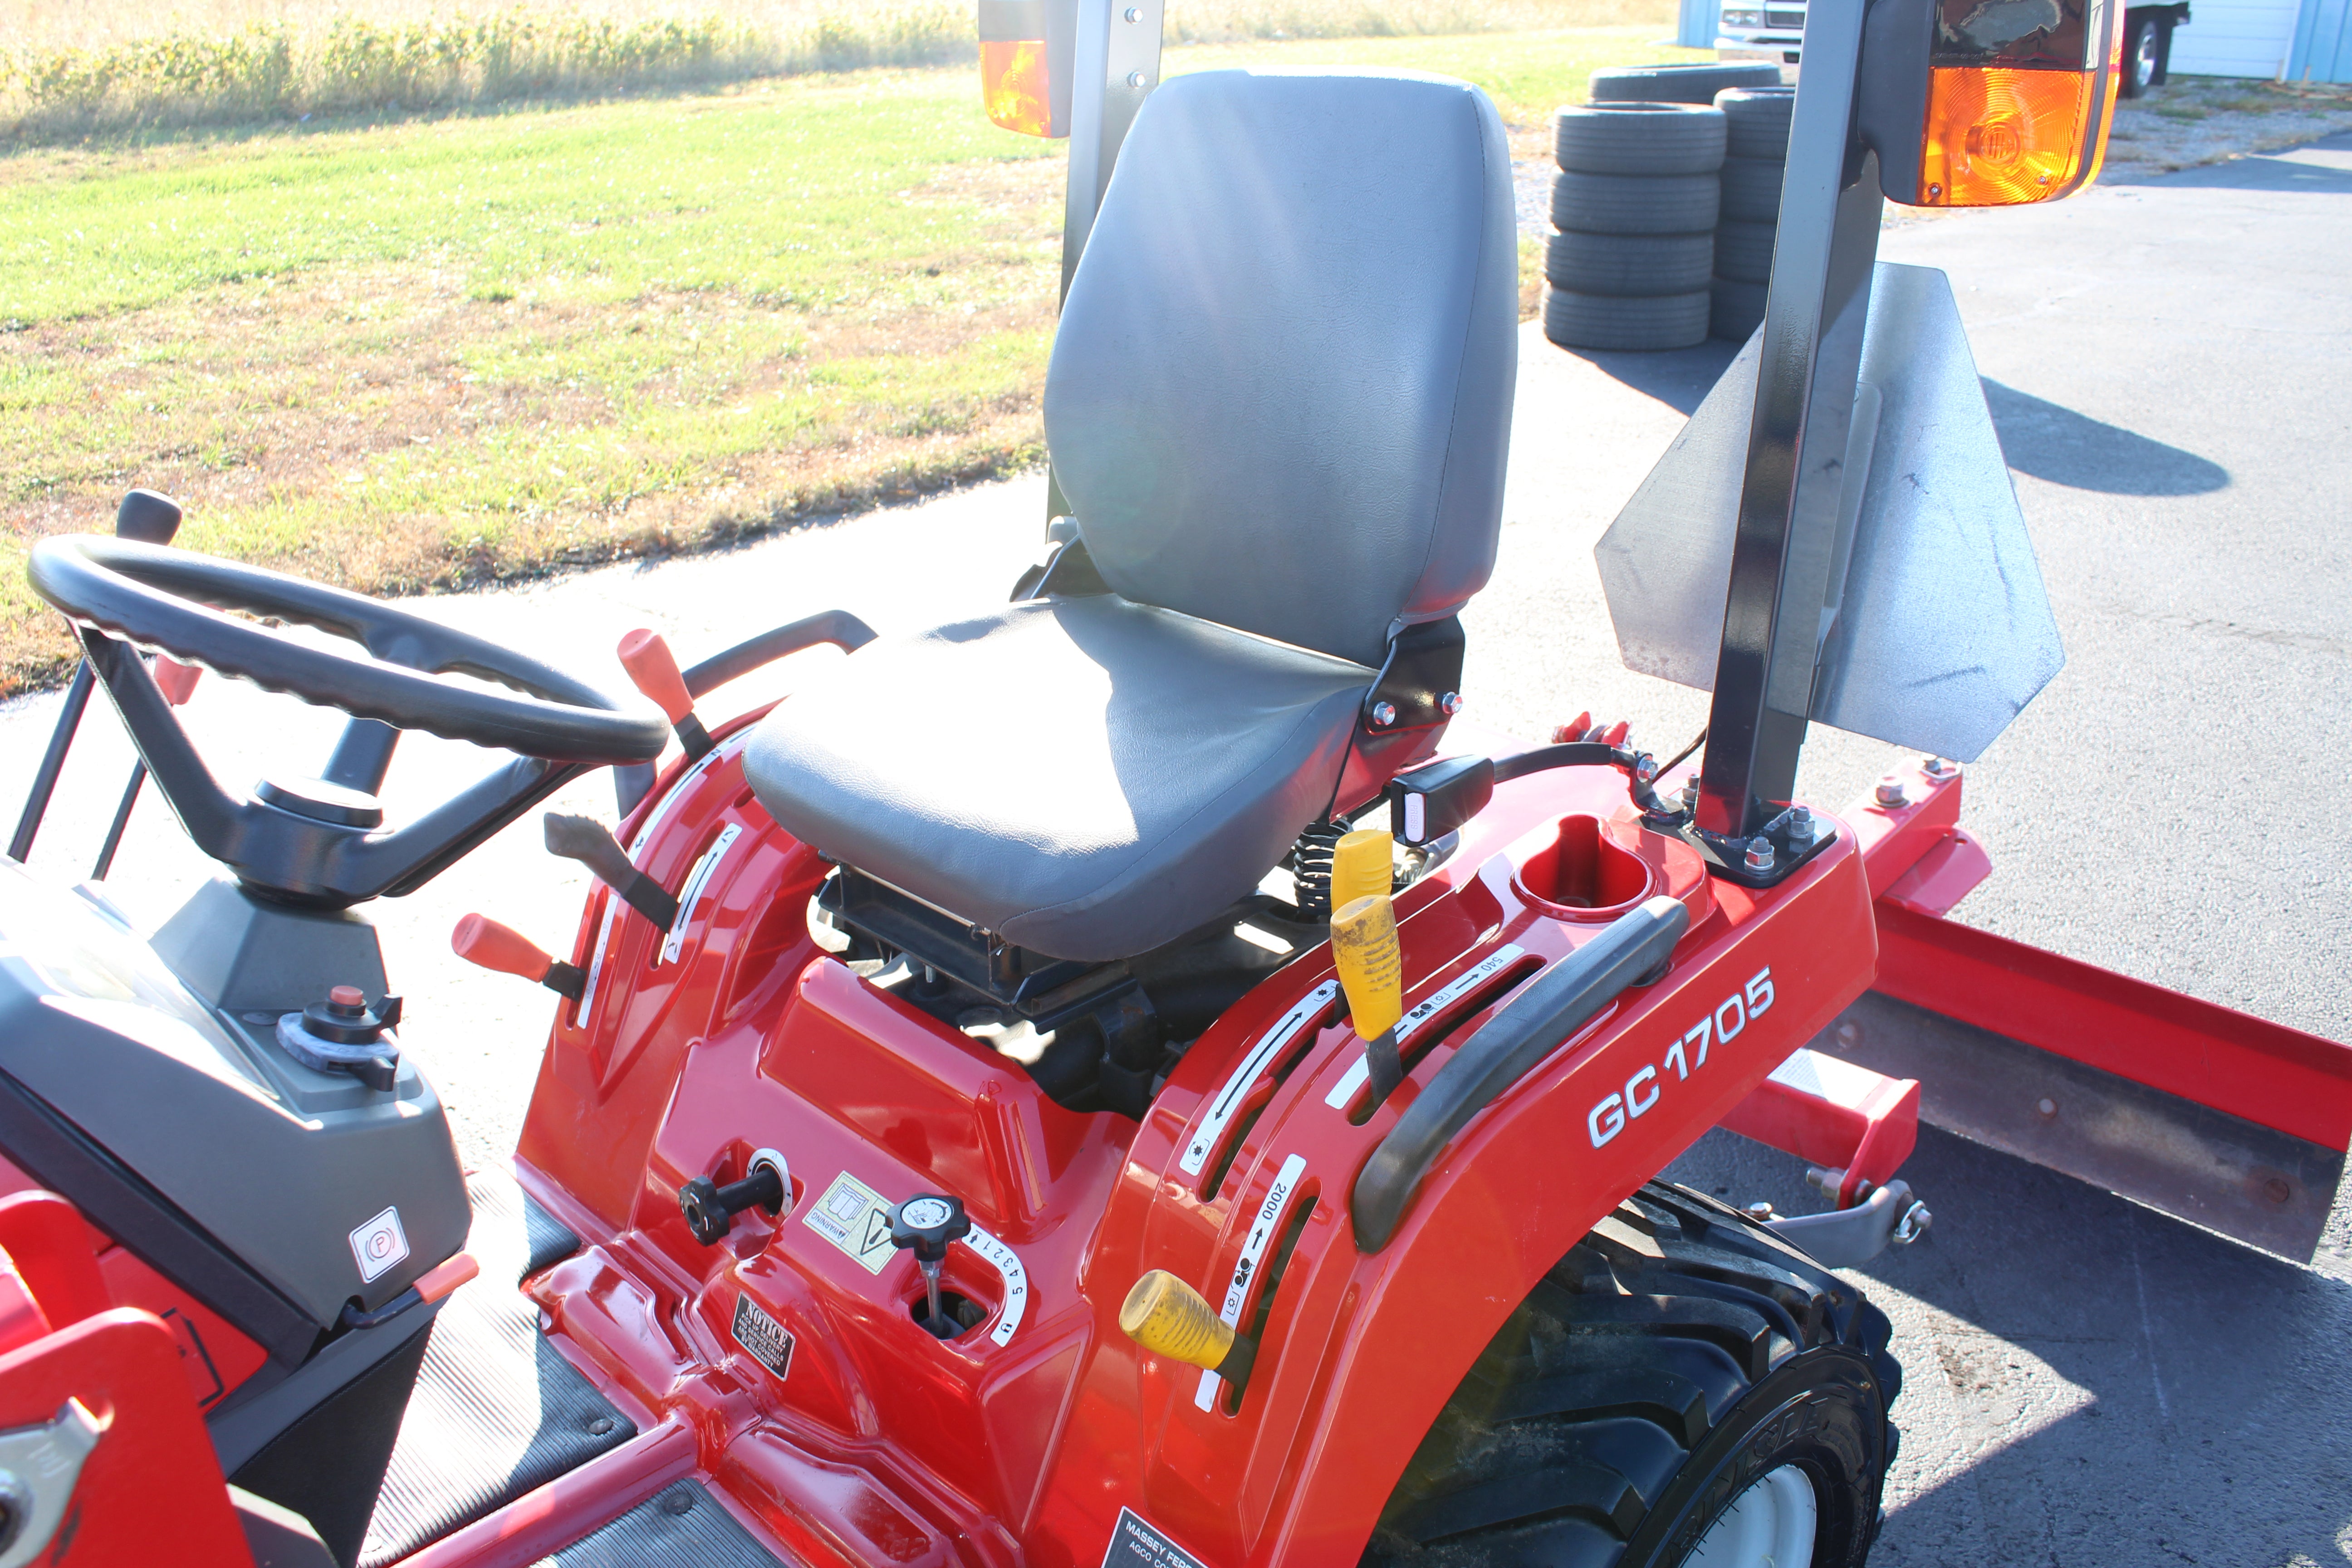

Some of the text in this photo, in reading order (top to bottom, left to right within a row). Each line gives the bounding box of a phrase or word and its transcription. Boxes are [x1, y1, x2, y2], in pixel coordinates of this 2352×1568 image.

[1480, 957, 1503, 971] 540
[1587, 1063, 1661, 1150] GC
[1663, 964, 1775, 1082] 1705
[1262, 1182, 1287, 1220] 2000
[811, 1211, 841, 1235] WARNING
[375, 1236, 385, 1253] P
[983, 1241, 991, 1250] 1
[994, 1248, 1004, 1259] 2
[1003, 1257, 1013, 1267] 3
[1009, 1269, 1019, 1277] 4
[738, 1318, 784, 1361] AND SERVICE CALLS
[741, 1313, 752, 1326] PICK
[760, 1331, 784, 1353] DELIVERY
[746, 1302, 788, 1349] NOTICE
[738, 1325, 781, 1366] ARE NOT COVERED
[741, 1336, 774, 1367] BY WARRANTY
[1126, 1520, 1166, 1556] MASSEY
[1129, 1541, 1170, 1568] AGCO CO
